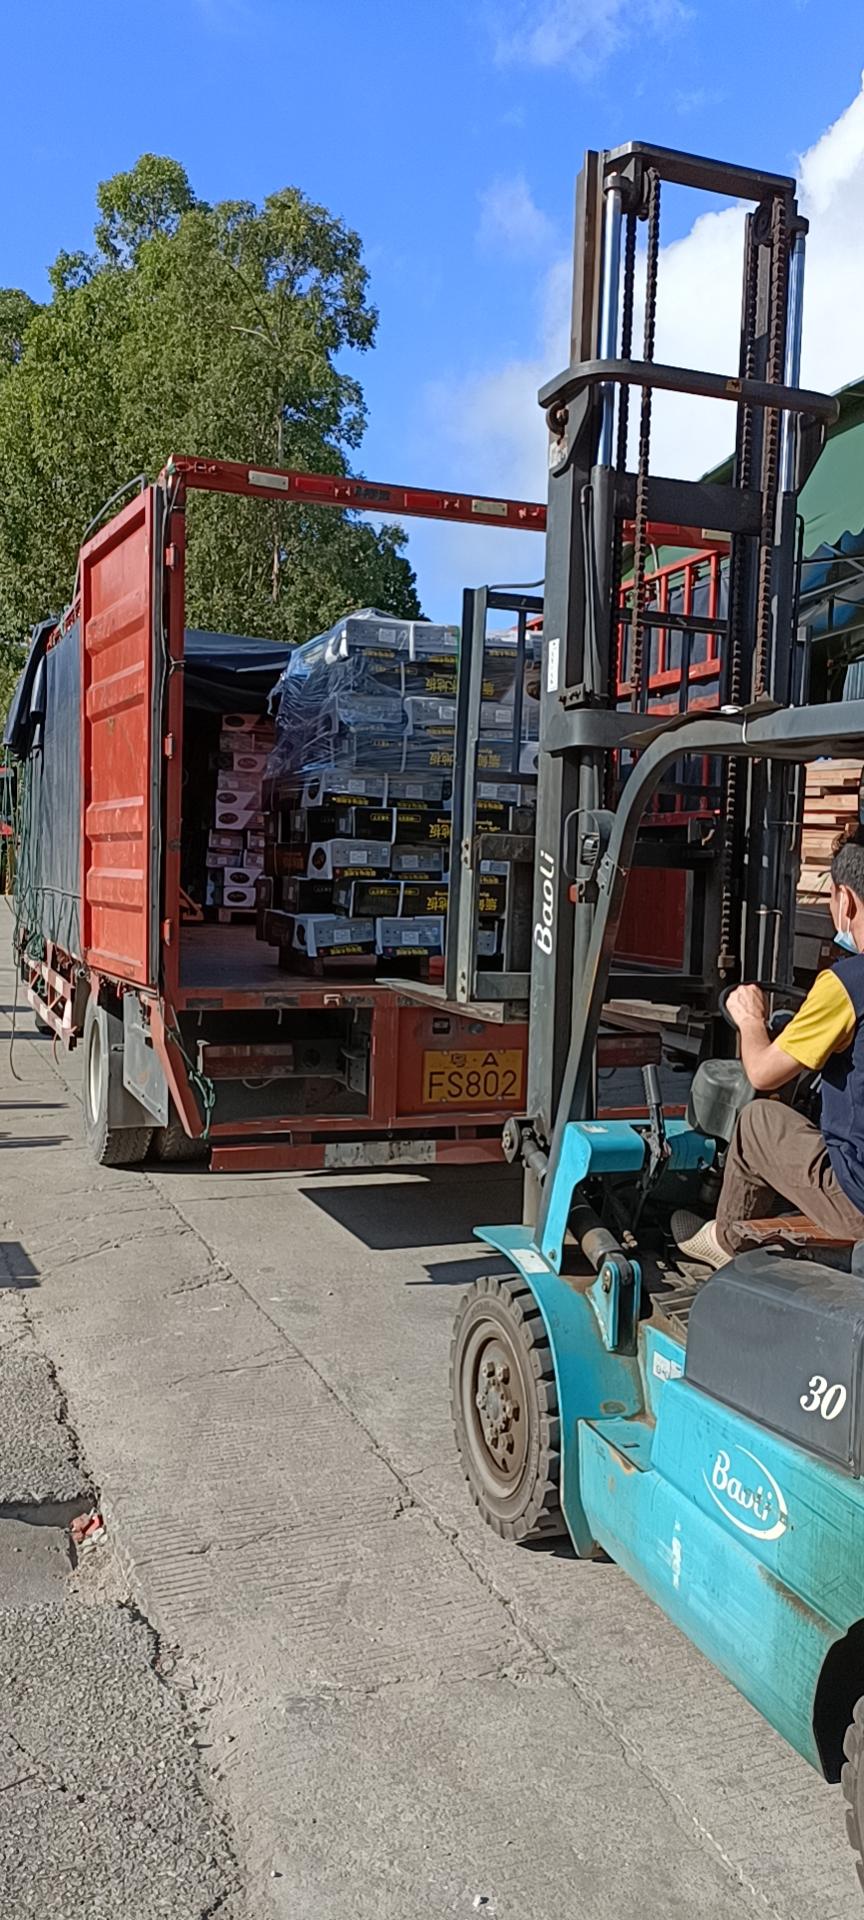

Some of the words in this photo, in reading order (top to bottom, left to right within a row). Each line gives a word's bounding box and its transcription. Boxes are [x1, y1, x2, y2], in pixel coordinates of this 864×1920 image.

[534, 850, 555, 955] Baoli
[429, 1070, 517, 1099] FS802
[799, 1375, 848, 1421] 30
